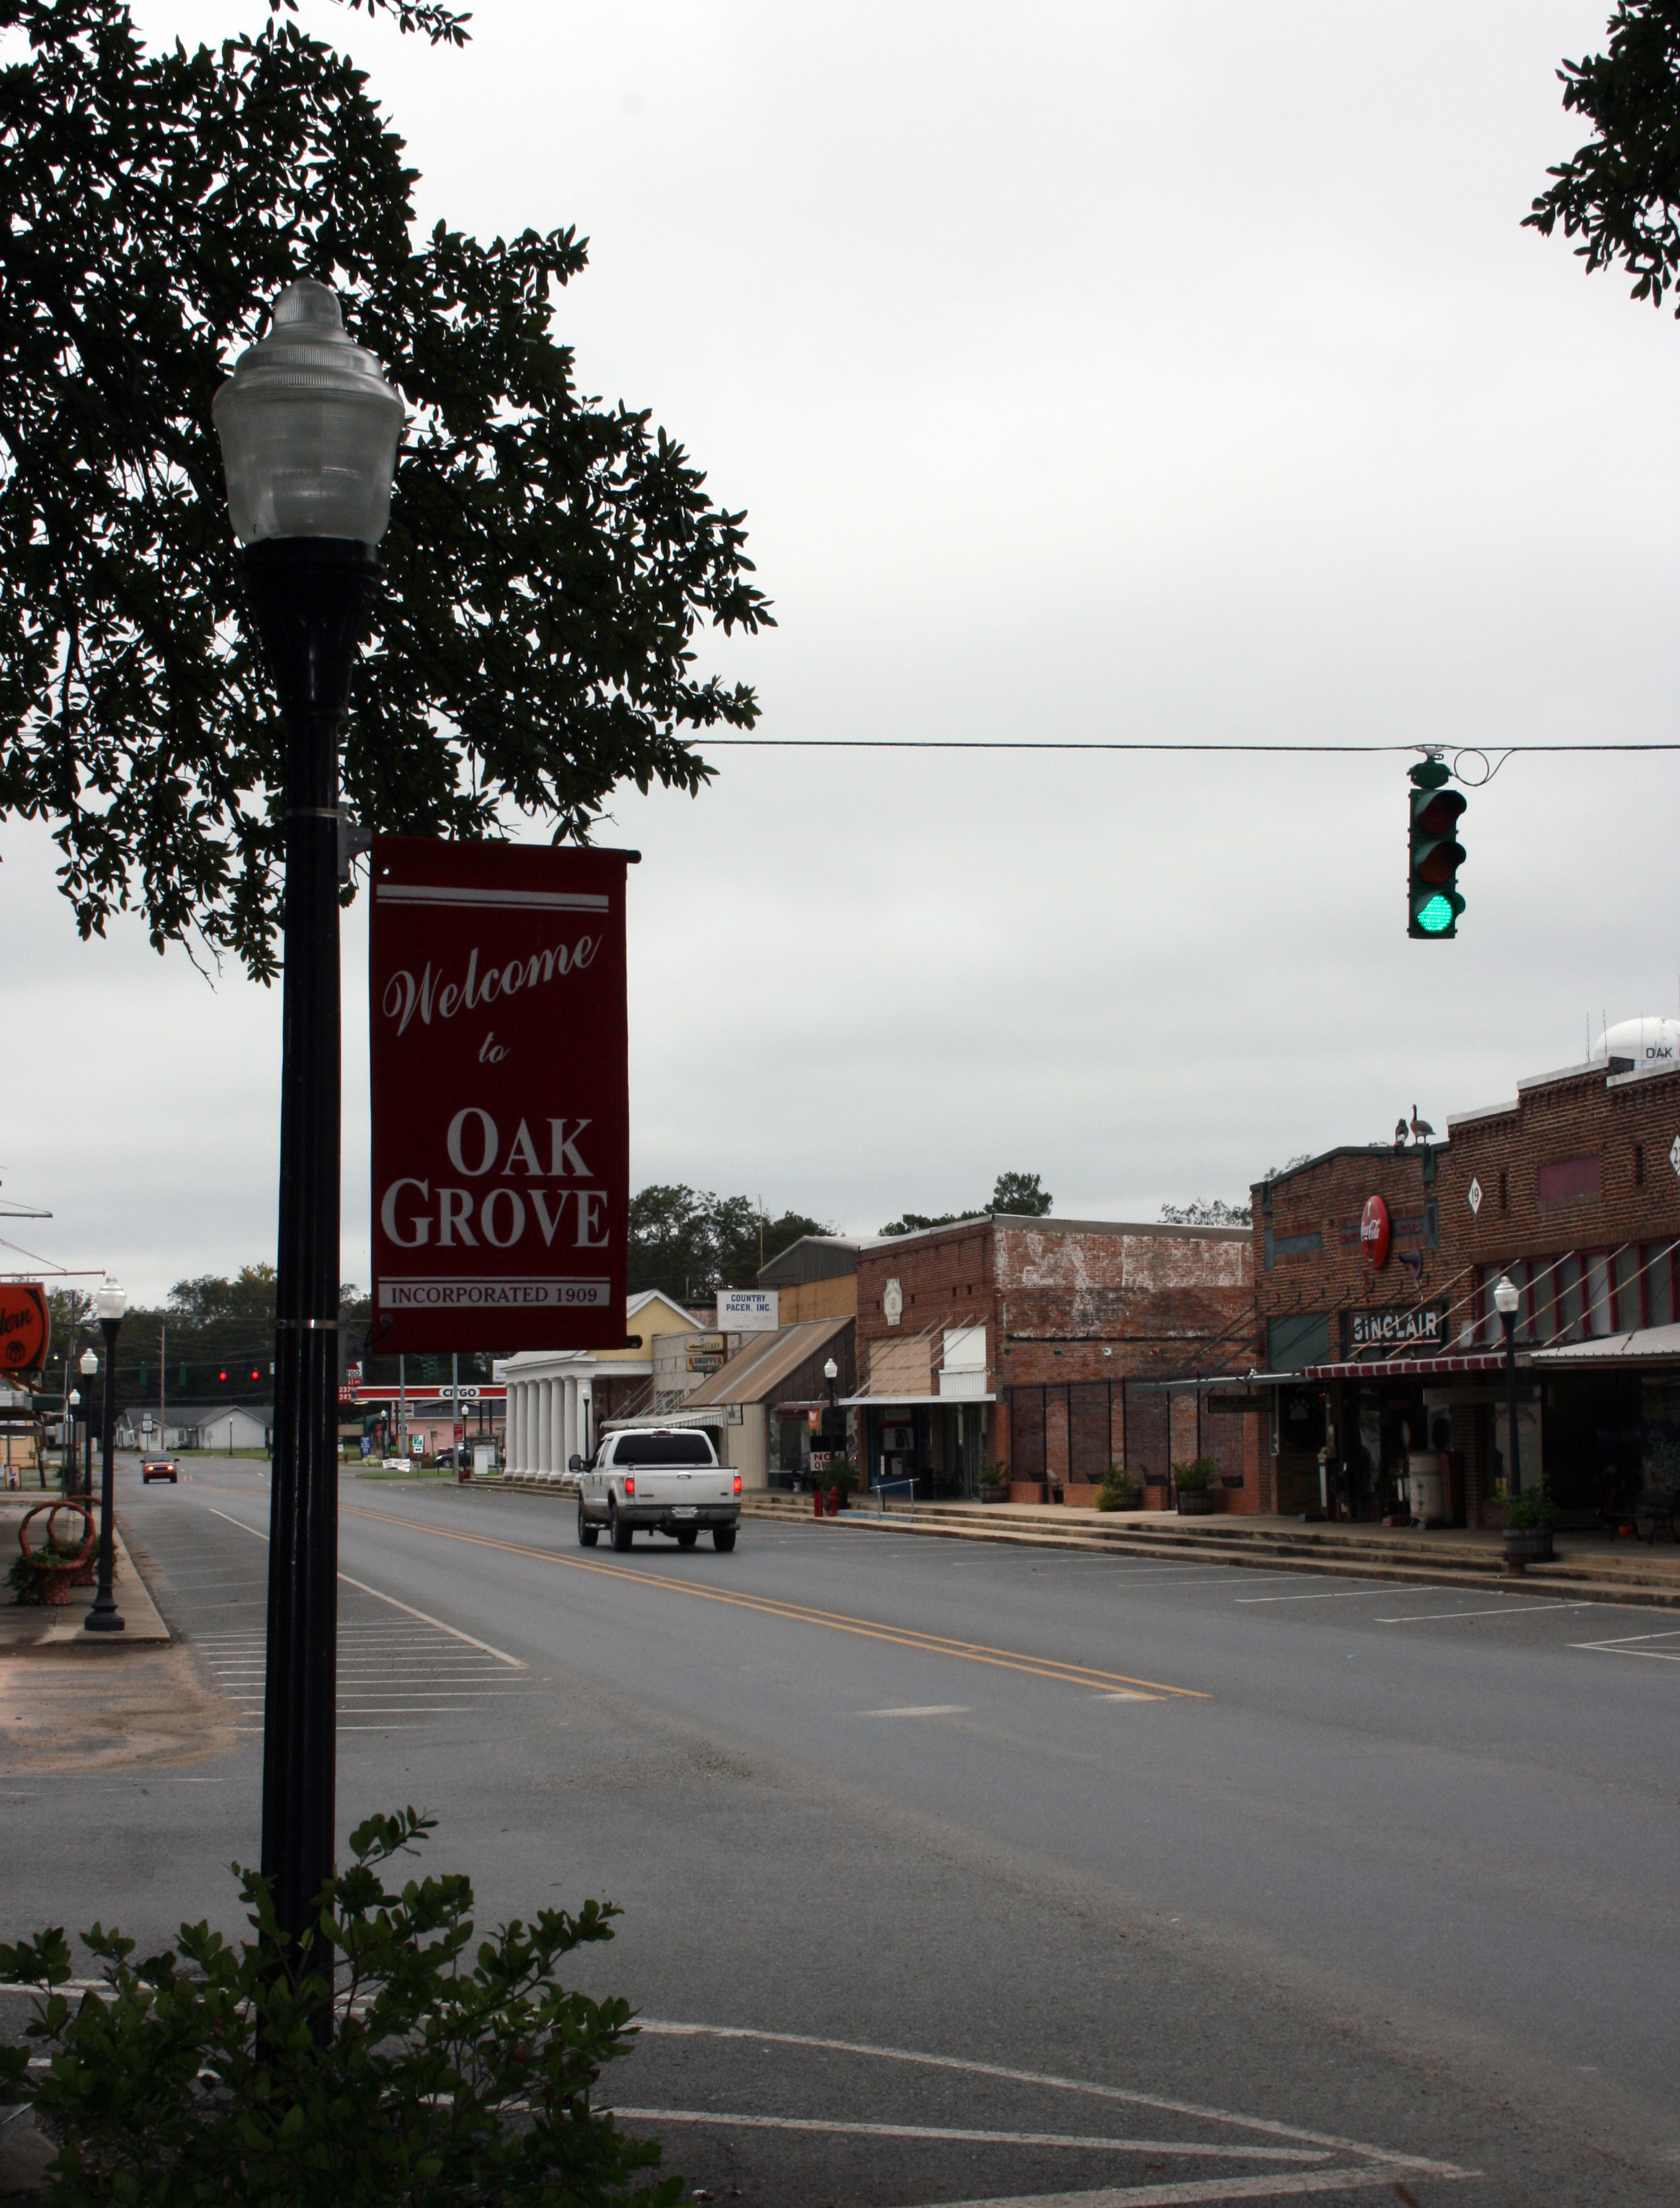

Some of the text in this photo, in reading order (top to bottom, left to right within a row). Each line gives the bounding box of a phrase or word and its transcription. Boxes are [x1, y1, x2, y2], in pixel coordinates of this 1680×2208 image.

[383, 935, 603, 1037] Welcome
[478, 1031, 510, 1064] to
[1646, 1047, 1673, 1058] OAK
[1471, 1187, 1479, 1203] 19
[391, 1286, 598, 1304] INCORPORATED 1909
[1354, 1312, 1437, 1341] SINCLAIR
